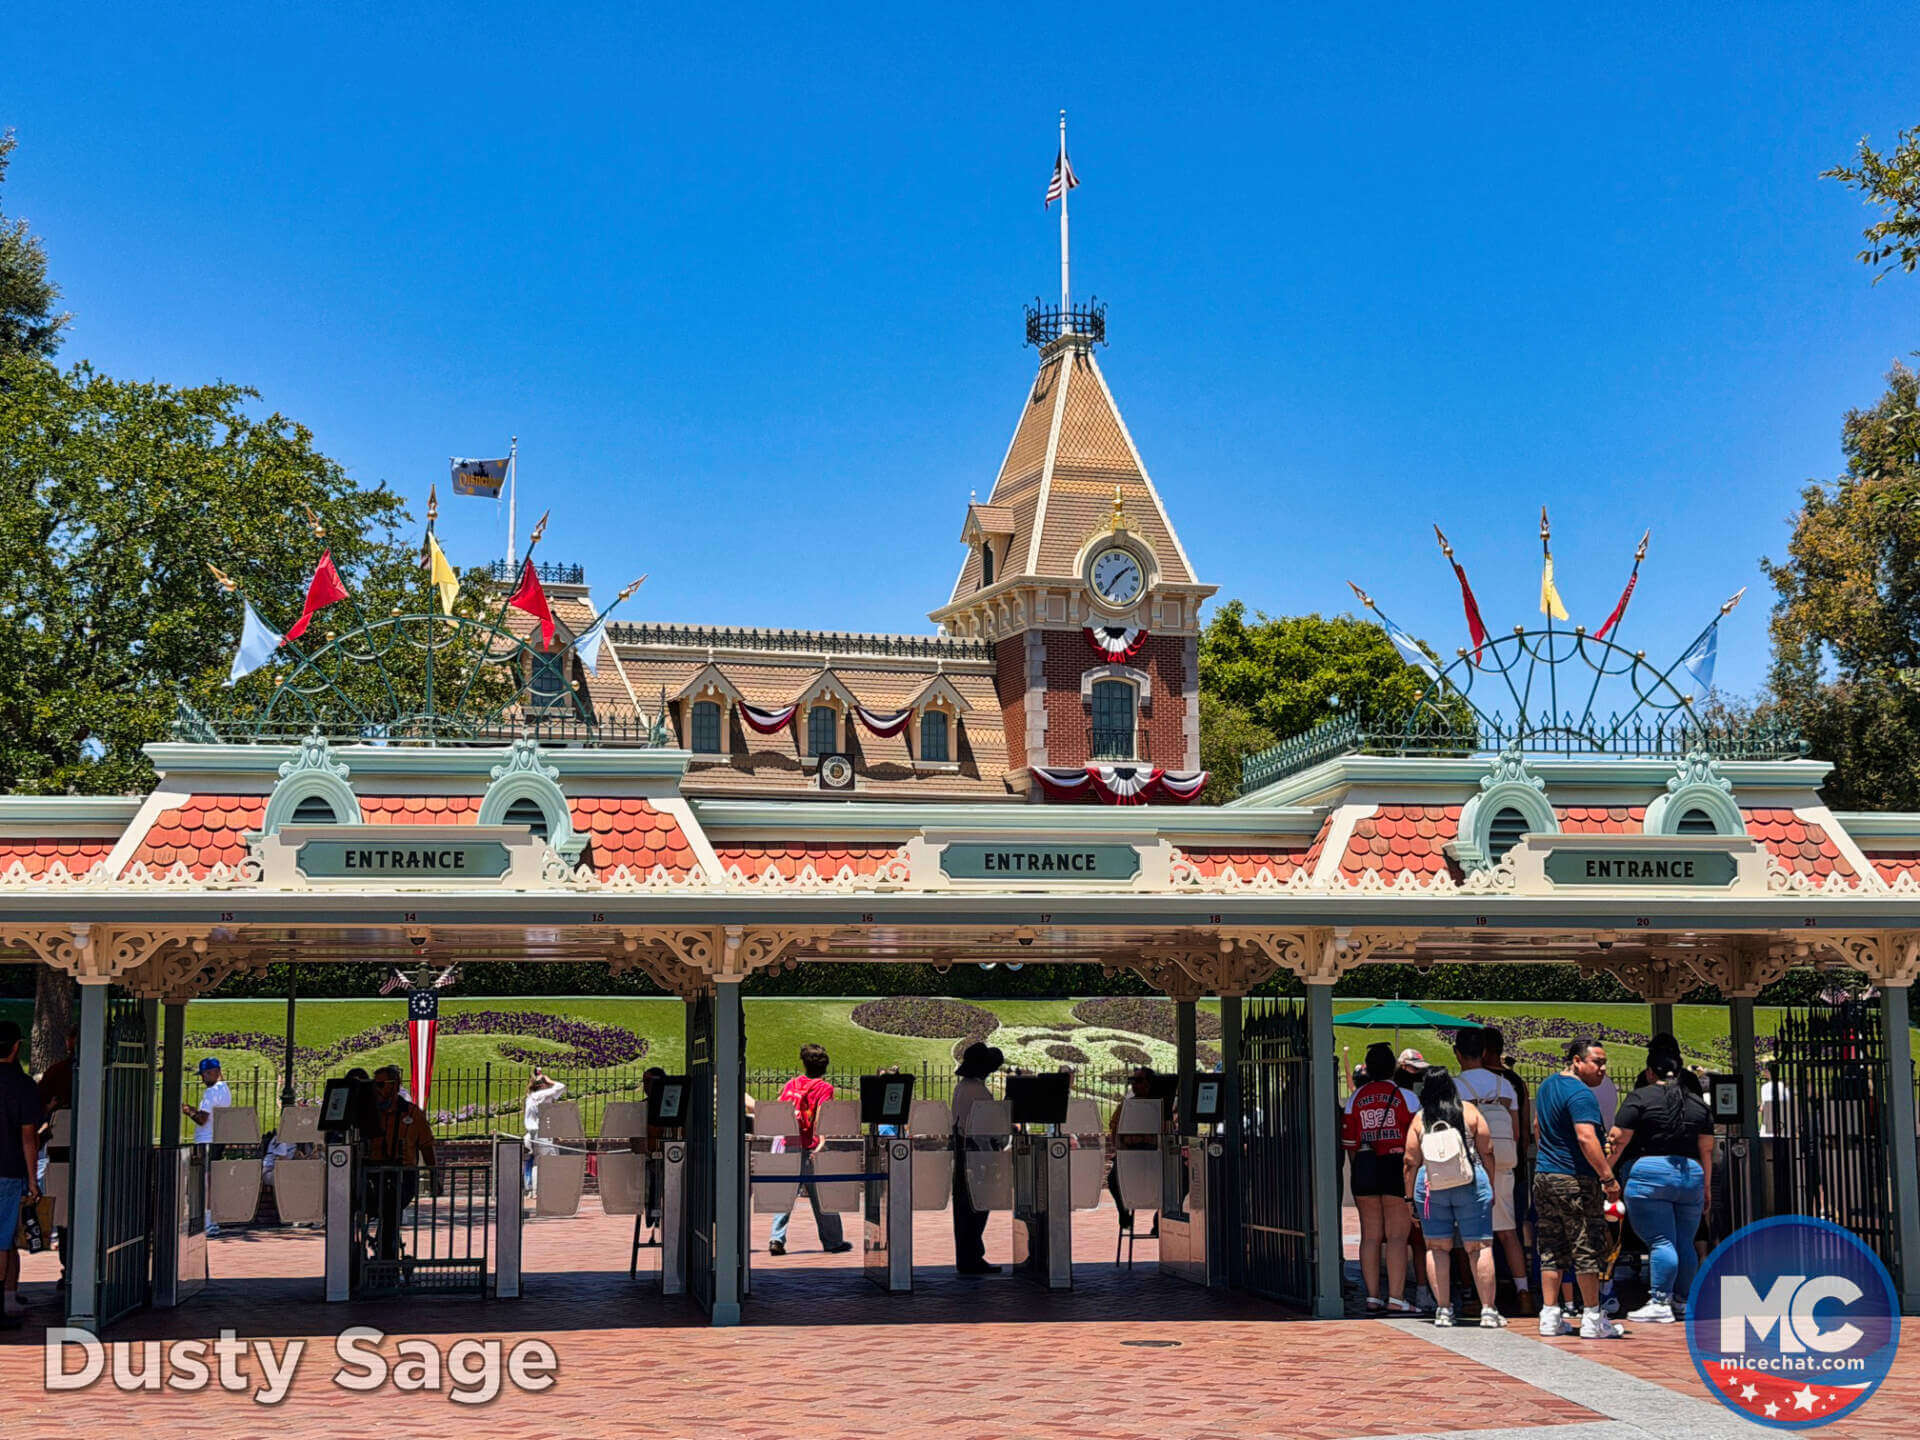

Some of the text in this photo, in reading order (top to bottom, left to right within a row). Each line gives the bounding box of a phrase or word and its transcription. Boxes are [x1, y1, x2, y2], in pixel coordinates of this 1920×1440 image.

[345, 850, 465, 869] ENTRANCE
[984, 852, 1096, 871] ENTRANCE
[1586, 860, 1694, 878] ENTRANCE
[221, 912, 233, 921] 13
[404, 912, 416, 922] 14
[592, 913, 605, 922] 15
[862, 913, 873, 922] 16
[1040, 914, 1052, 923] 17
[1210, 914, 1221, 924] 18
[1475, 915, 1487, 925] 19
[1636, 917, 1649, 927] 20
[1804, 917, 1816, 927] 21
[1360, 1108, 1396, 1129] 1928
[1361, 1128, 1402, 1141] ORINAL
